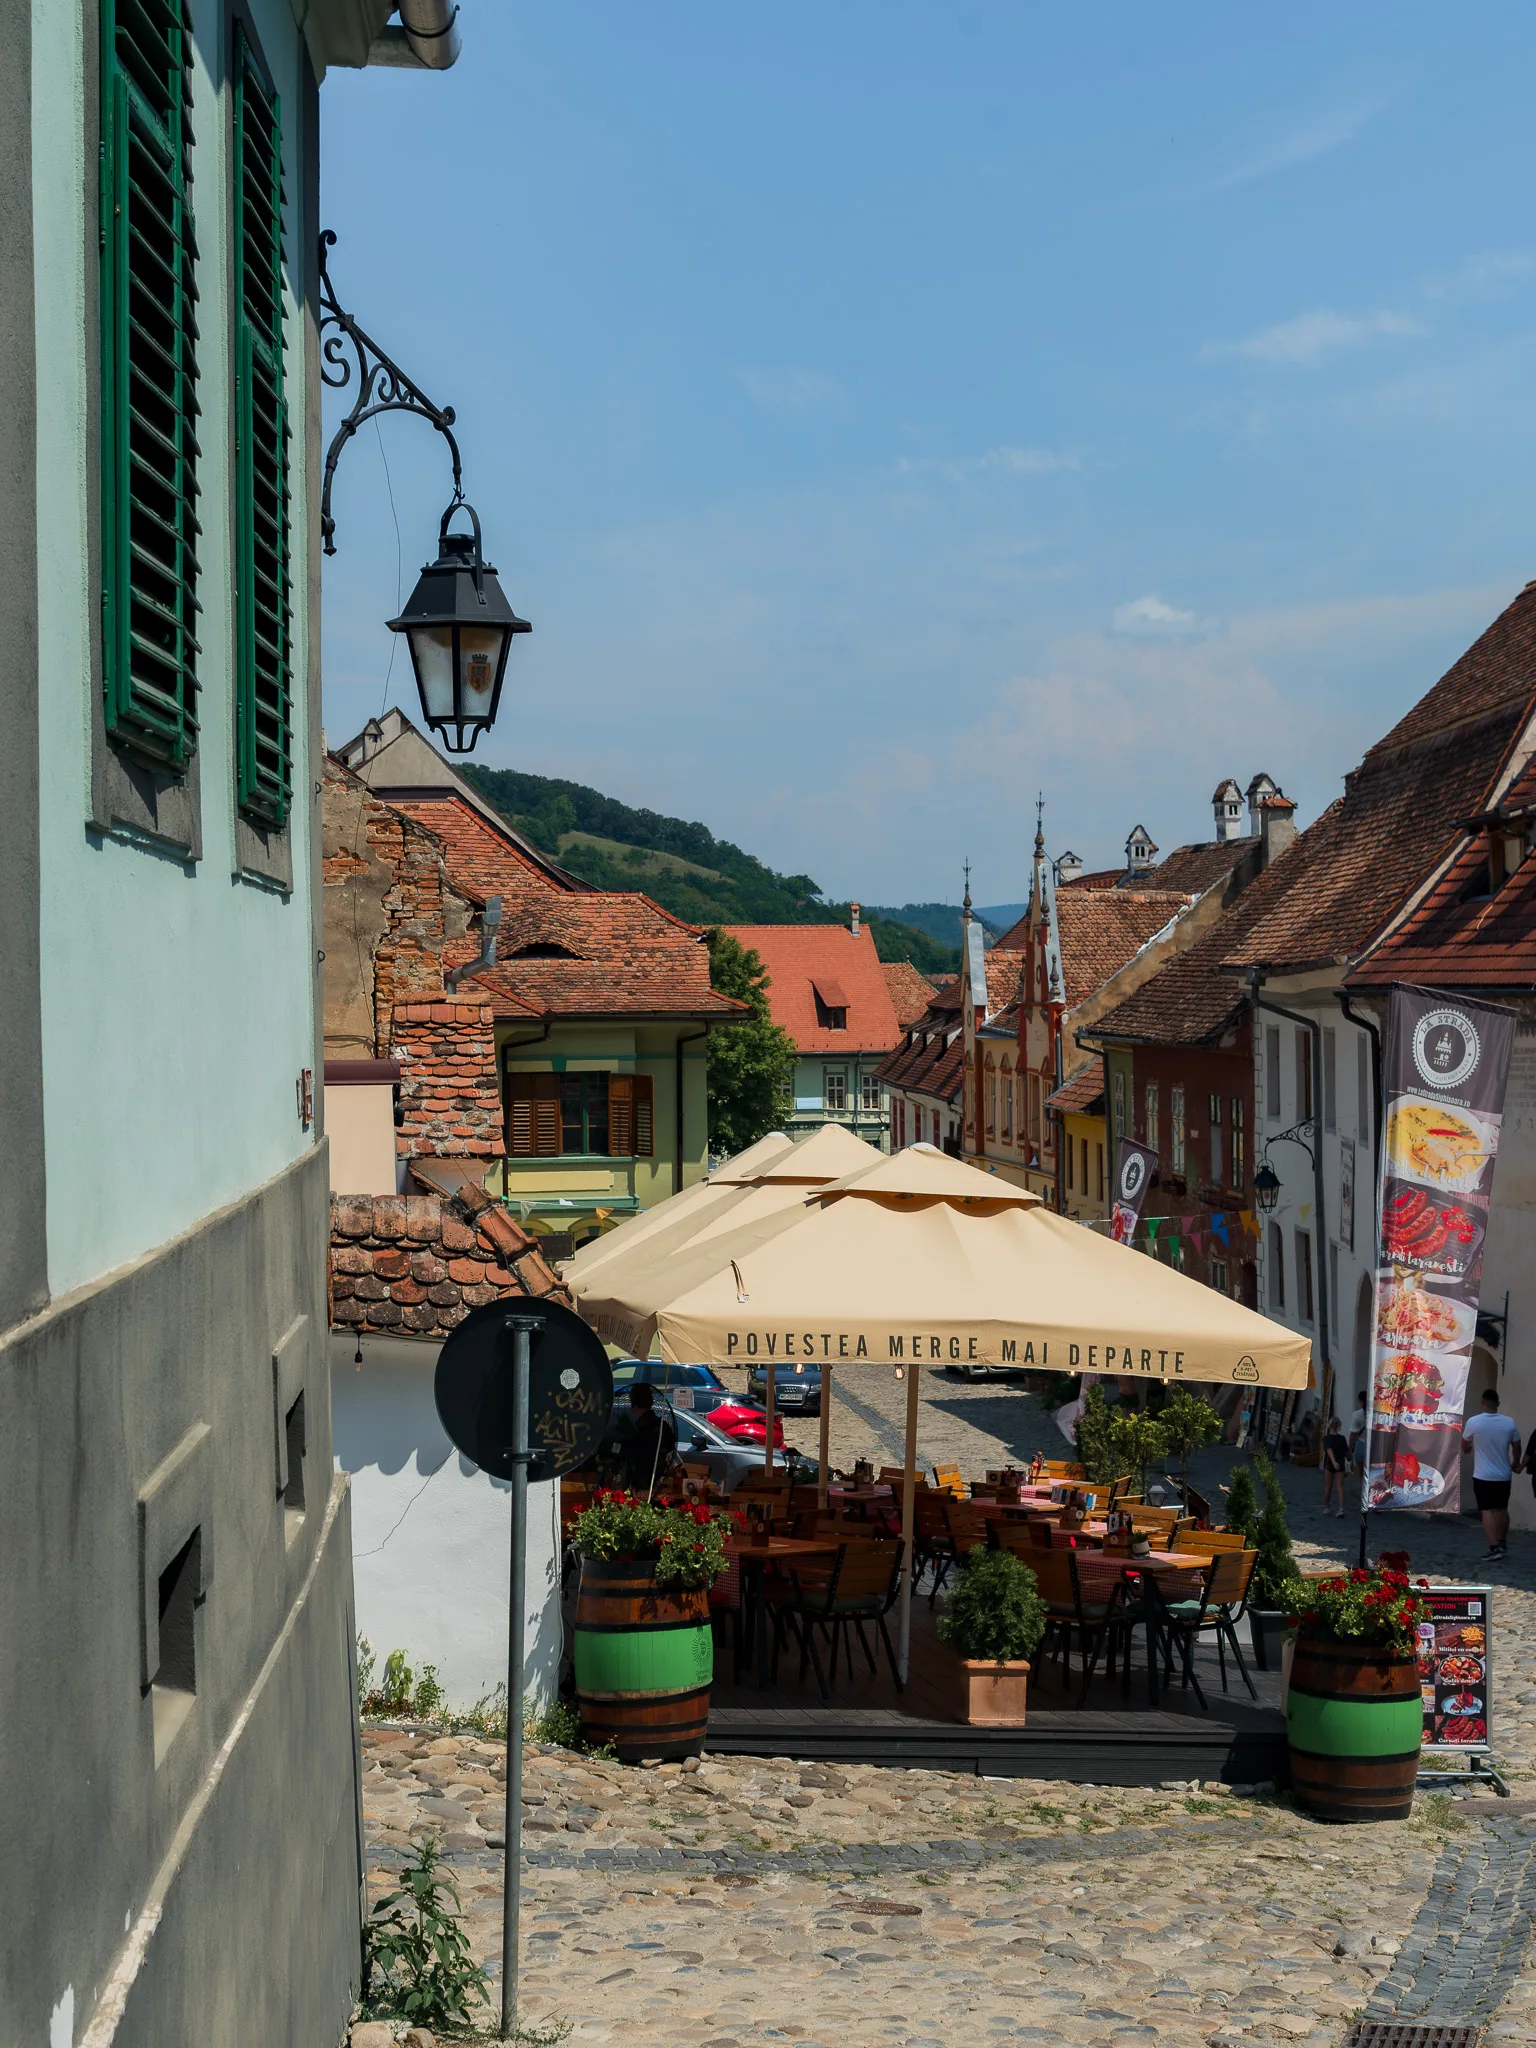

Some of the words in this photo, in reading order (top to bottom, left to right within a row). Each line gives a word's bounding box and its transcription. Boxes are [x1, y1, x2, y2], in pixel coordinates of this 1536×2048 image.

[1421, 1021, 1434, 1034] LA
[1437, 1015, 1473, 1044] STRADA
[727, 1333, 868, 1357] POVESTEA
[889, 1335, 978, 1359] MERGE
[1002, 1339, 1048, 1364] MAI
[1069, 1343, 1185, 1374] DEPARTE
